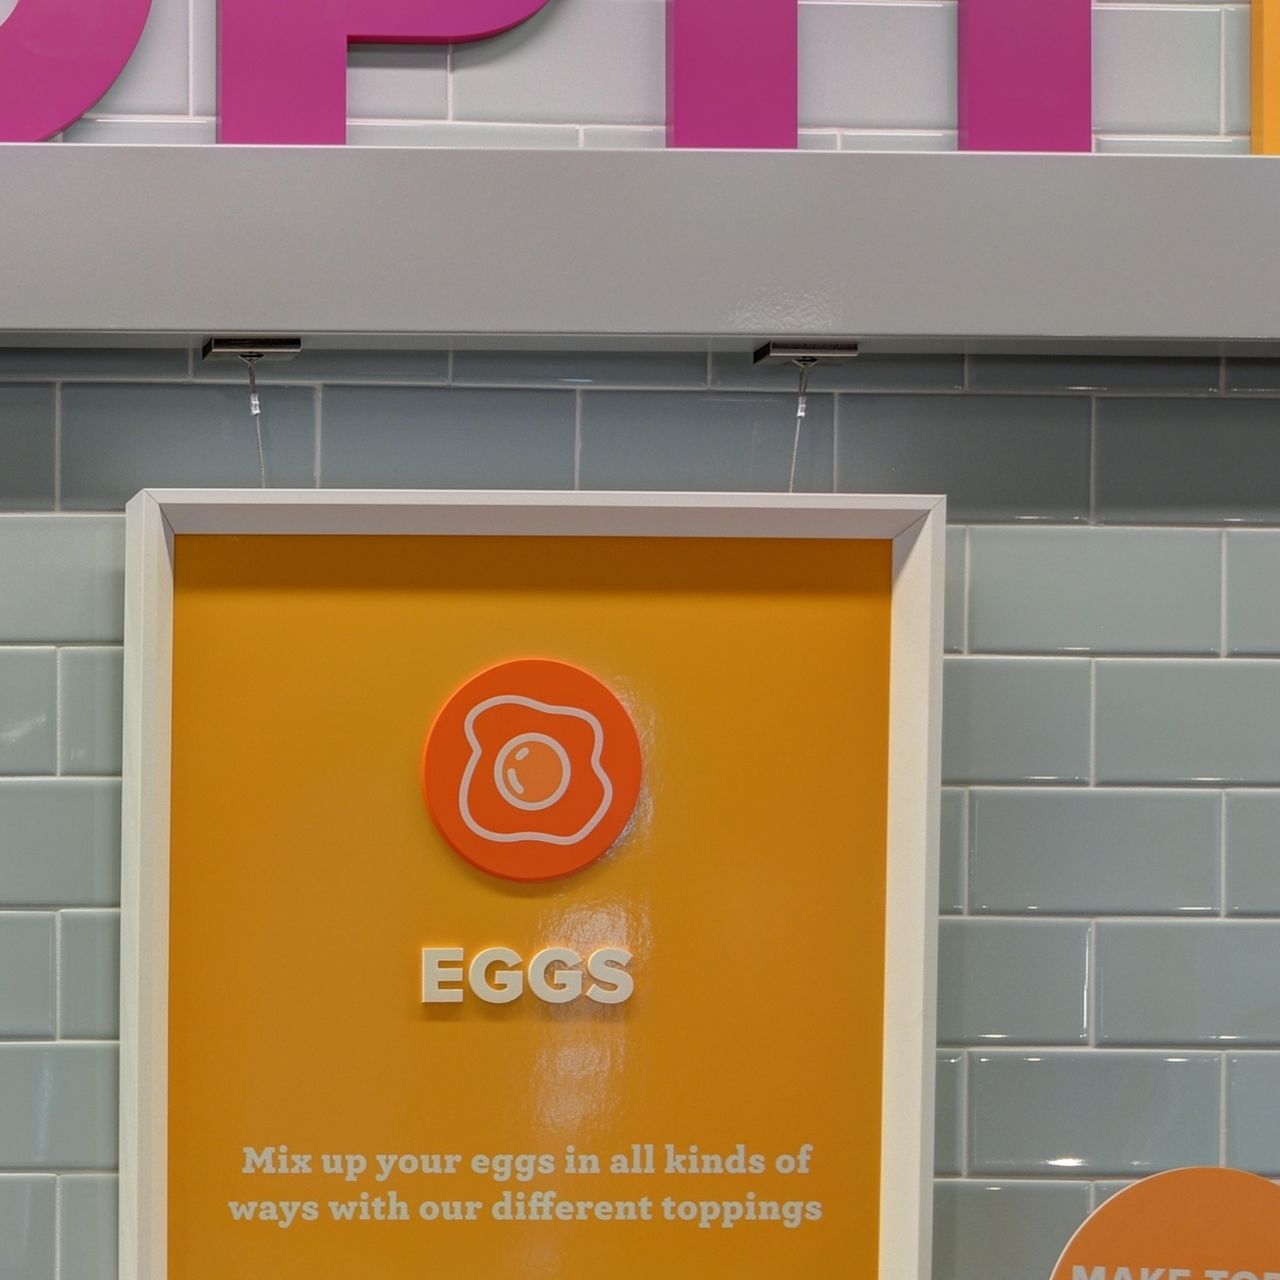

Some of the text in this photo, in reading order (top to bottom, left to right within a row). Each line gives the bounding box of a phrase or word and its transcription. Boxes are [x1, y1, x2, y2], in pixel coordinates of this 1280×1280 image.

[420, 947, 634, 1004] EGGS
[242, 1144, 812, 1181] Mix up your eggs in all kinds of
[228, 1192, 822, 1228] ways with our different toppings
